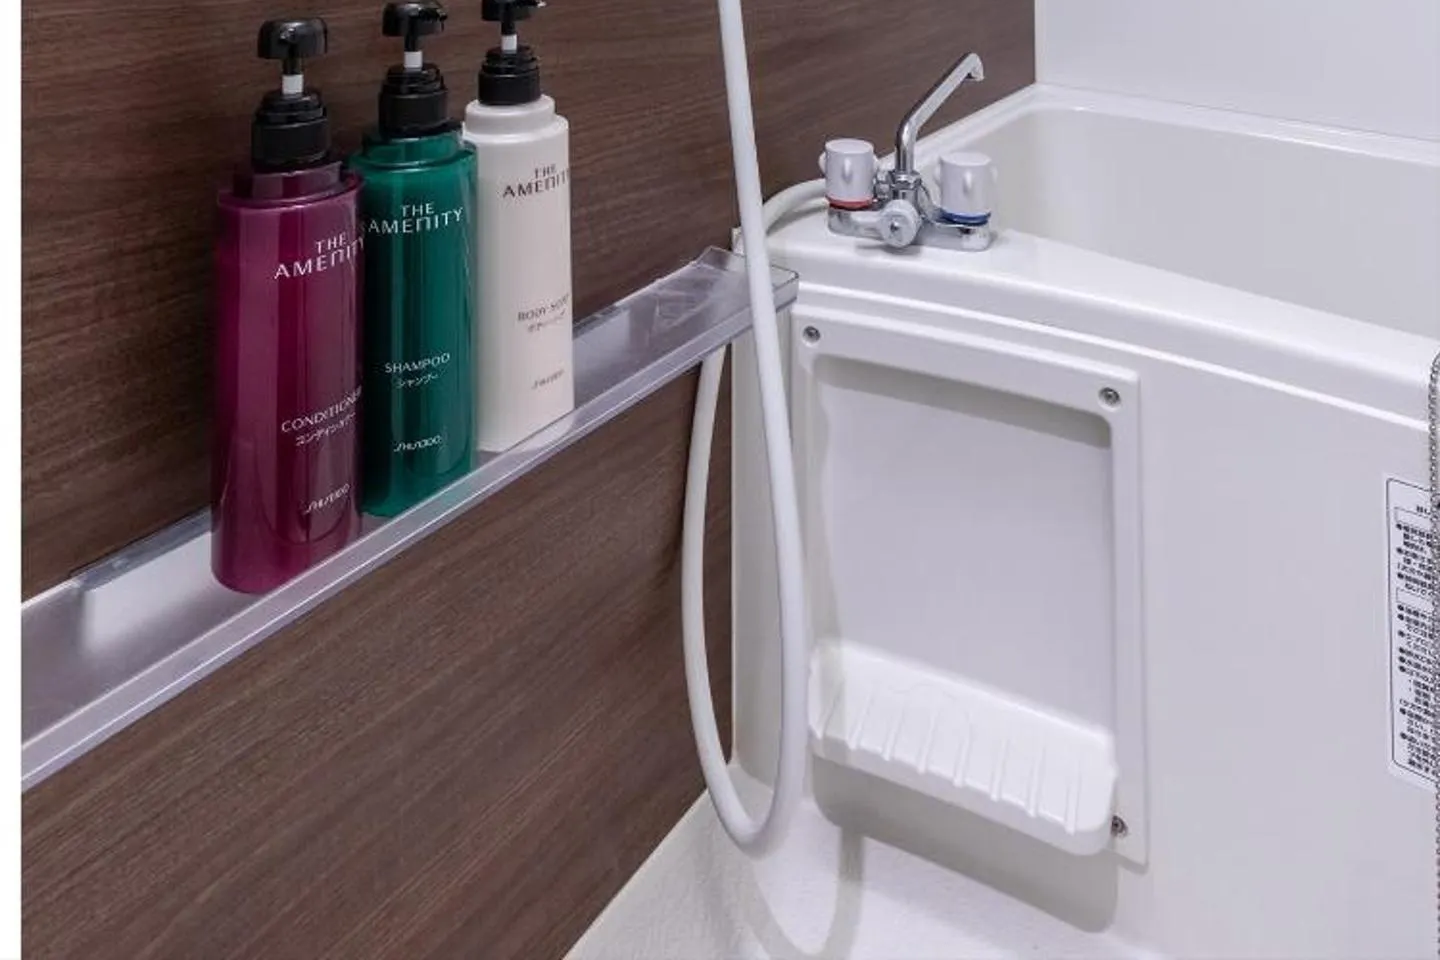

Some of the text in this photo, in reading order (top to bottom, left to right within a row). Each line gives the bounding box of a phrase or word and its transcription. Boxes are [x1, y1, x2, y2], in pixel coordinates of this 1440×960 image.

[368, 206, 464, 234] AMENITY
[401, 202, 435, 217] THE
[316, 231, 347, 254] THE
[384, 352, 450, 373] SHAMPOO
[281, 384, 362, 432] CONDITION
